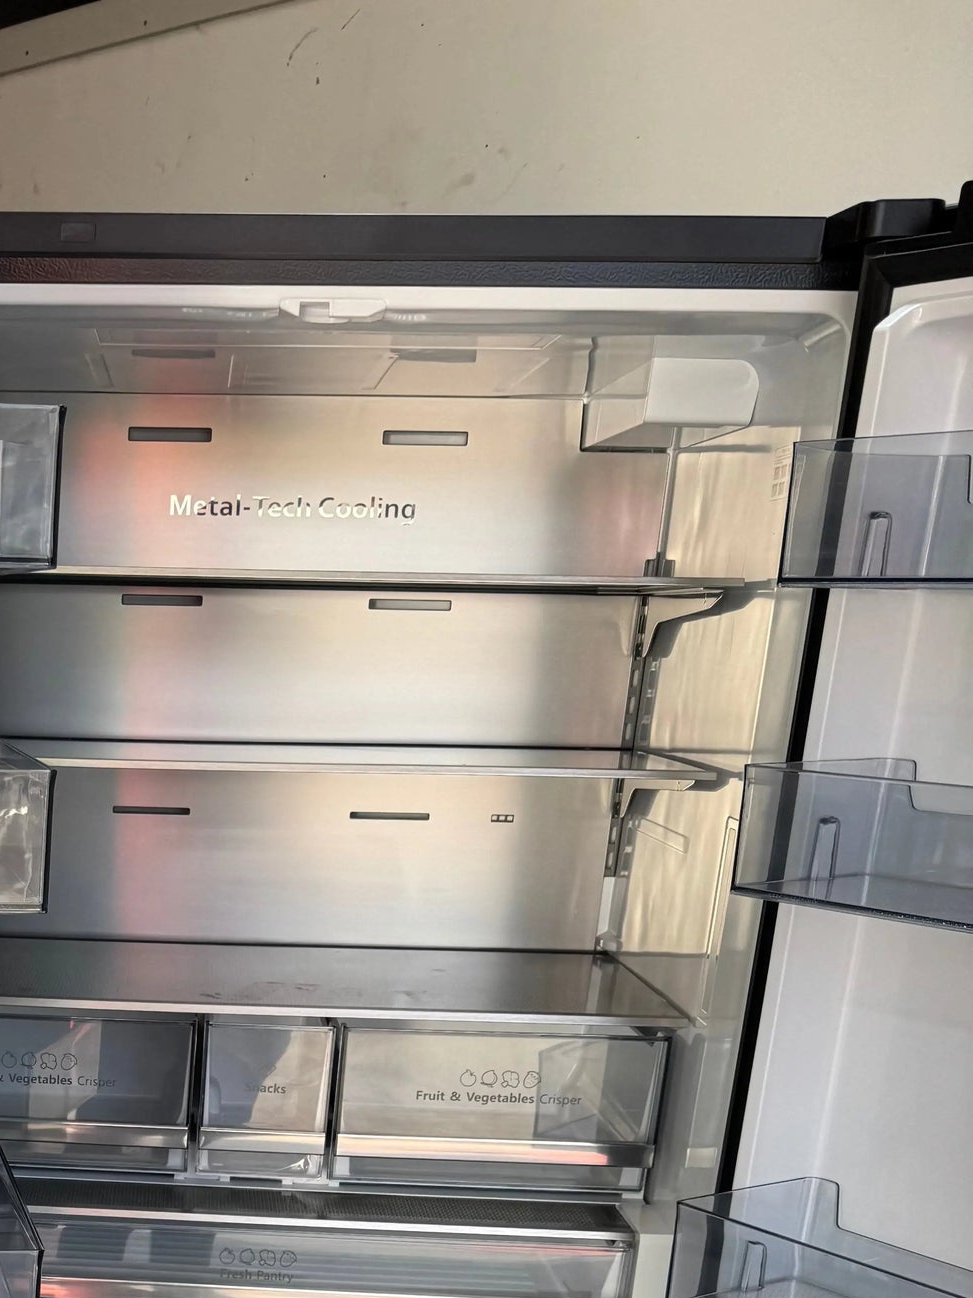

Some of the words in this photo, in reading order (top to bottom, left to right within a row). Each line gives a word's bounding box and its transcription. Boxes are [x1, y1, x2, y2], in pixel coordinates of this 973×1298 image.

[169, 494, 311, 518] Metal-Tech
[318, 496, 416, 526] Cooling
[8, 1073, 73, 1086] Vegetables
[77, 1075, 117, 1089] Crisper
[415, 1090, 445, 1101] Fruit
[449, 1091, 461, 1102] &
[466, 1091, 535, 1105] Vegetables
[539, 1093, 582, 1108] Crisper
[219, 1268, 253, 1280] Fresh
[256, 1270, 294, 1283] Pantry
